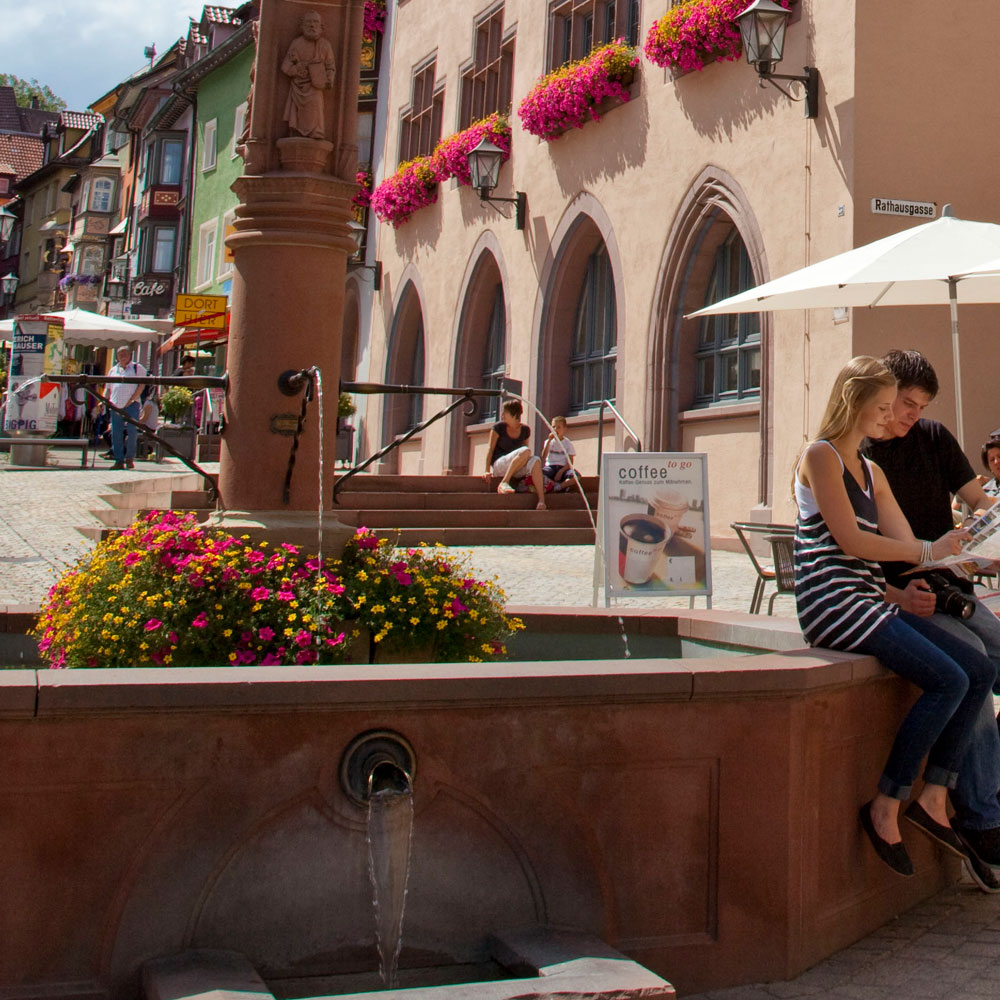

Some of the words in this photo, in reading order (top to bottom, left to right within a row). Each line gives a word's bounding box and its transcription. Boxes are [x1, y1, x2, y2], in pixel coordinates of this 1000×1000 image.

[875, 199, 934, 216] Rathausgasse
[184, 297, 219, 310] DORT
[184, 313, 217, 325] HIER
[618, 465, 668, 479] coffee
[667, 460, 677, 468] to
[679, 461, 693, 471] go
